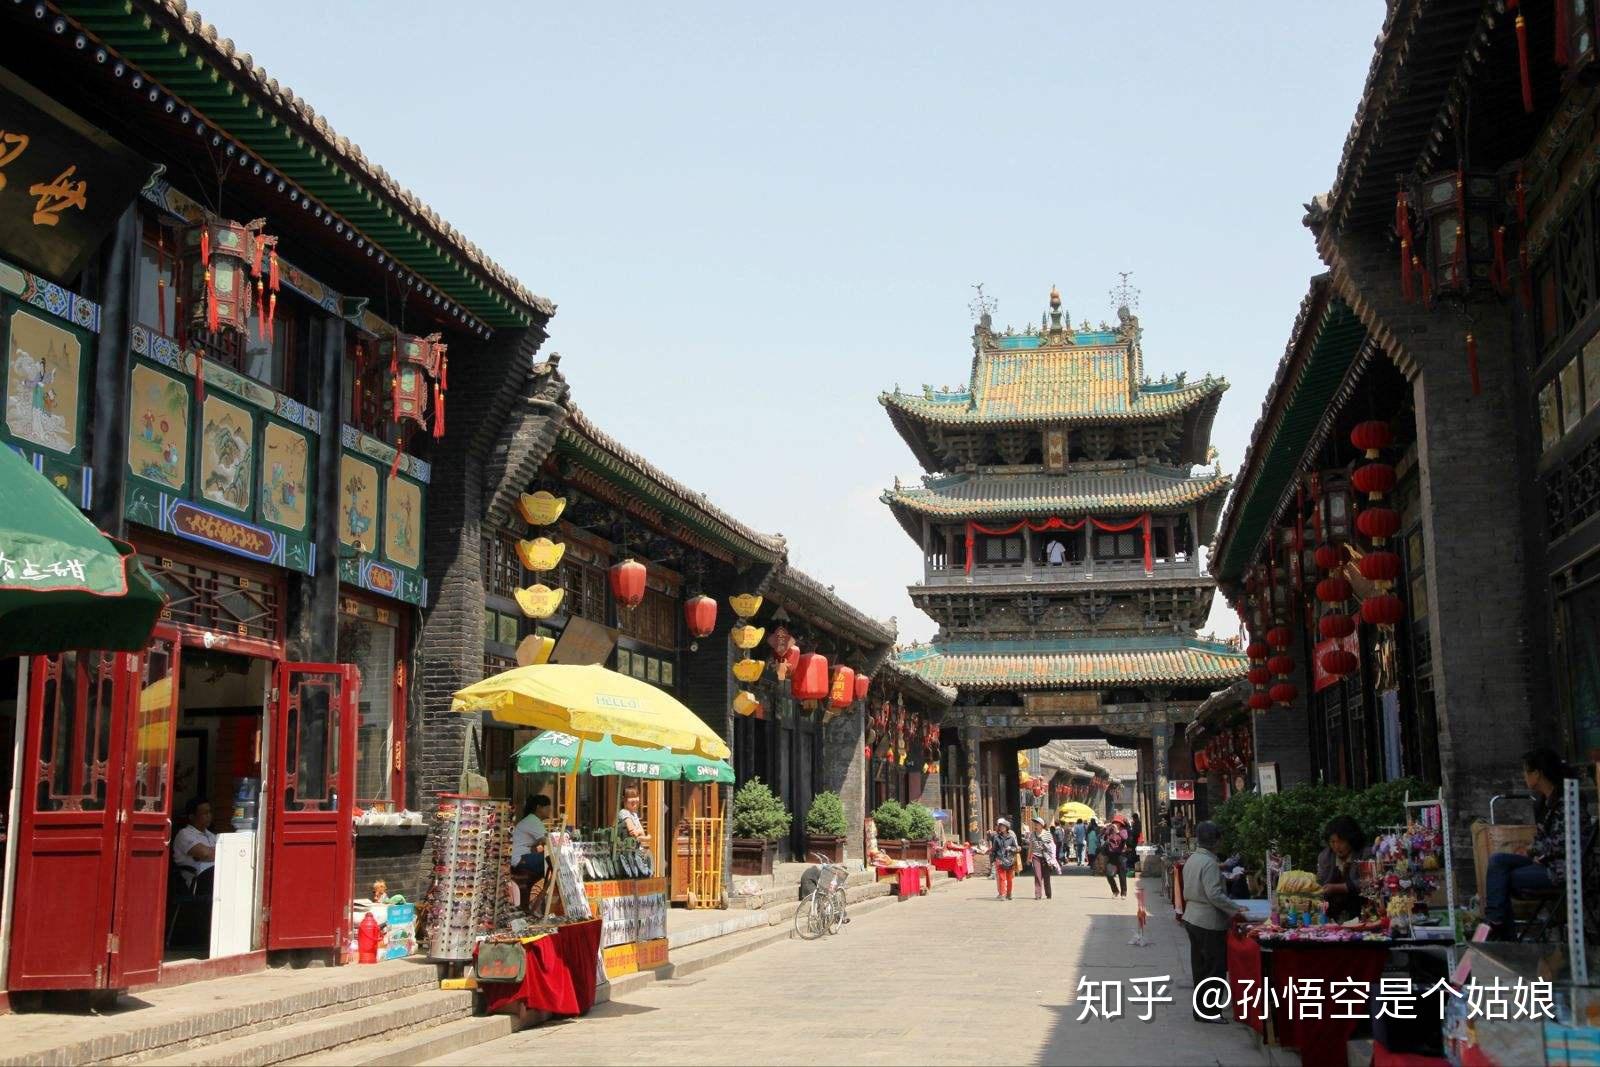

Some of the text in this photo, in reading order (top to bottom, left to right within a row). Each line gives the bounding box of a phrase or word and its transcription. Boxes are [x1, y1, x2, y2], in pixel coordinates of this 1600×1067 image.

[539, 756, 569, 769] SNOW
[614, 760, 660, 776] 雪花啤酒
[697, 765, 719, 777] SNOW
